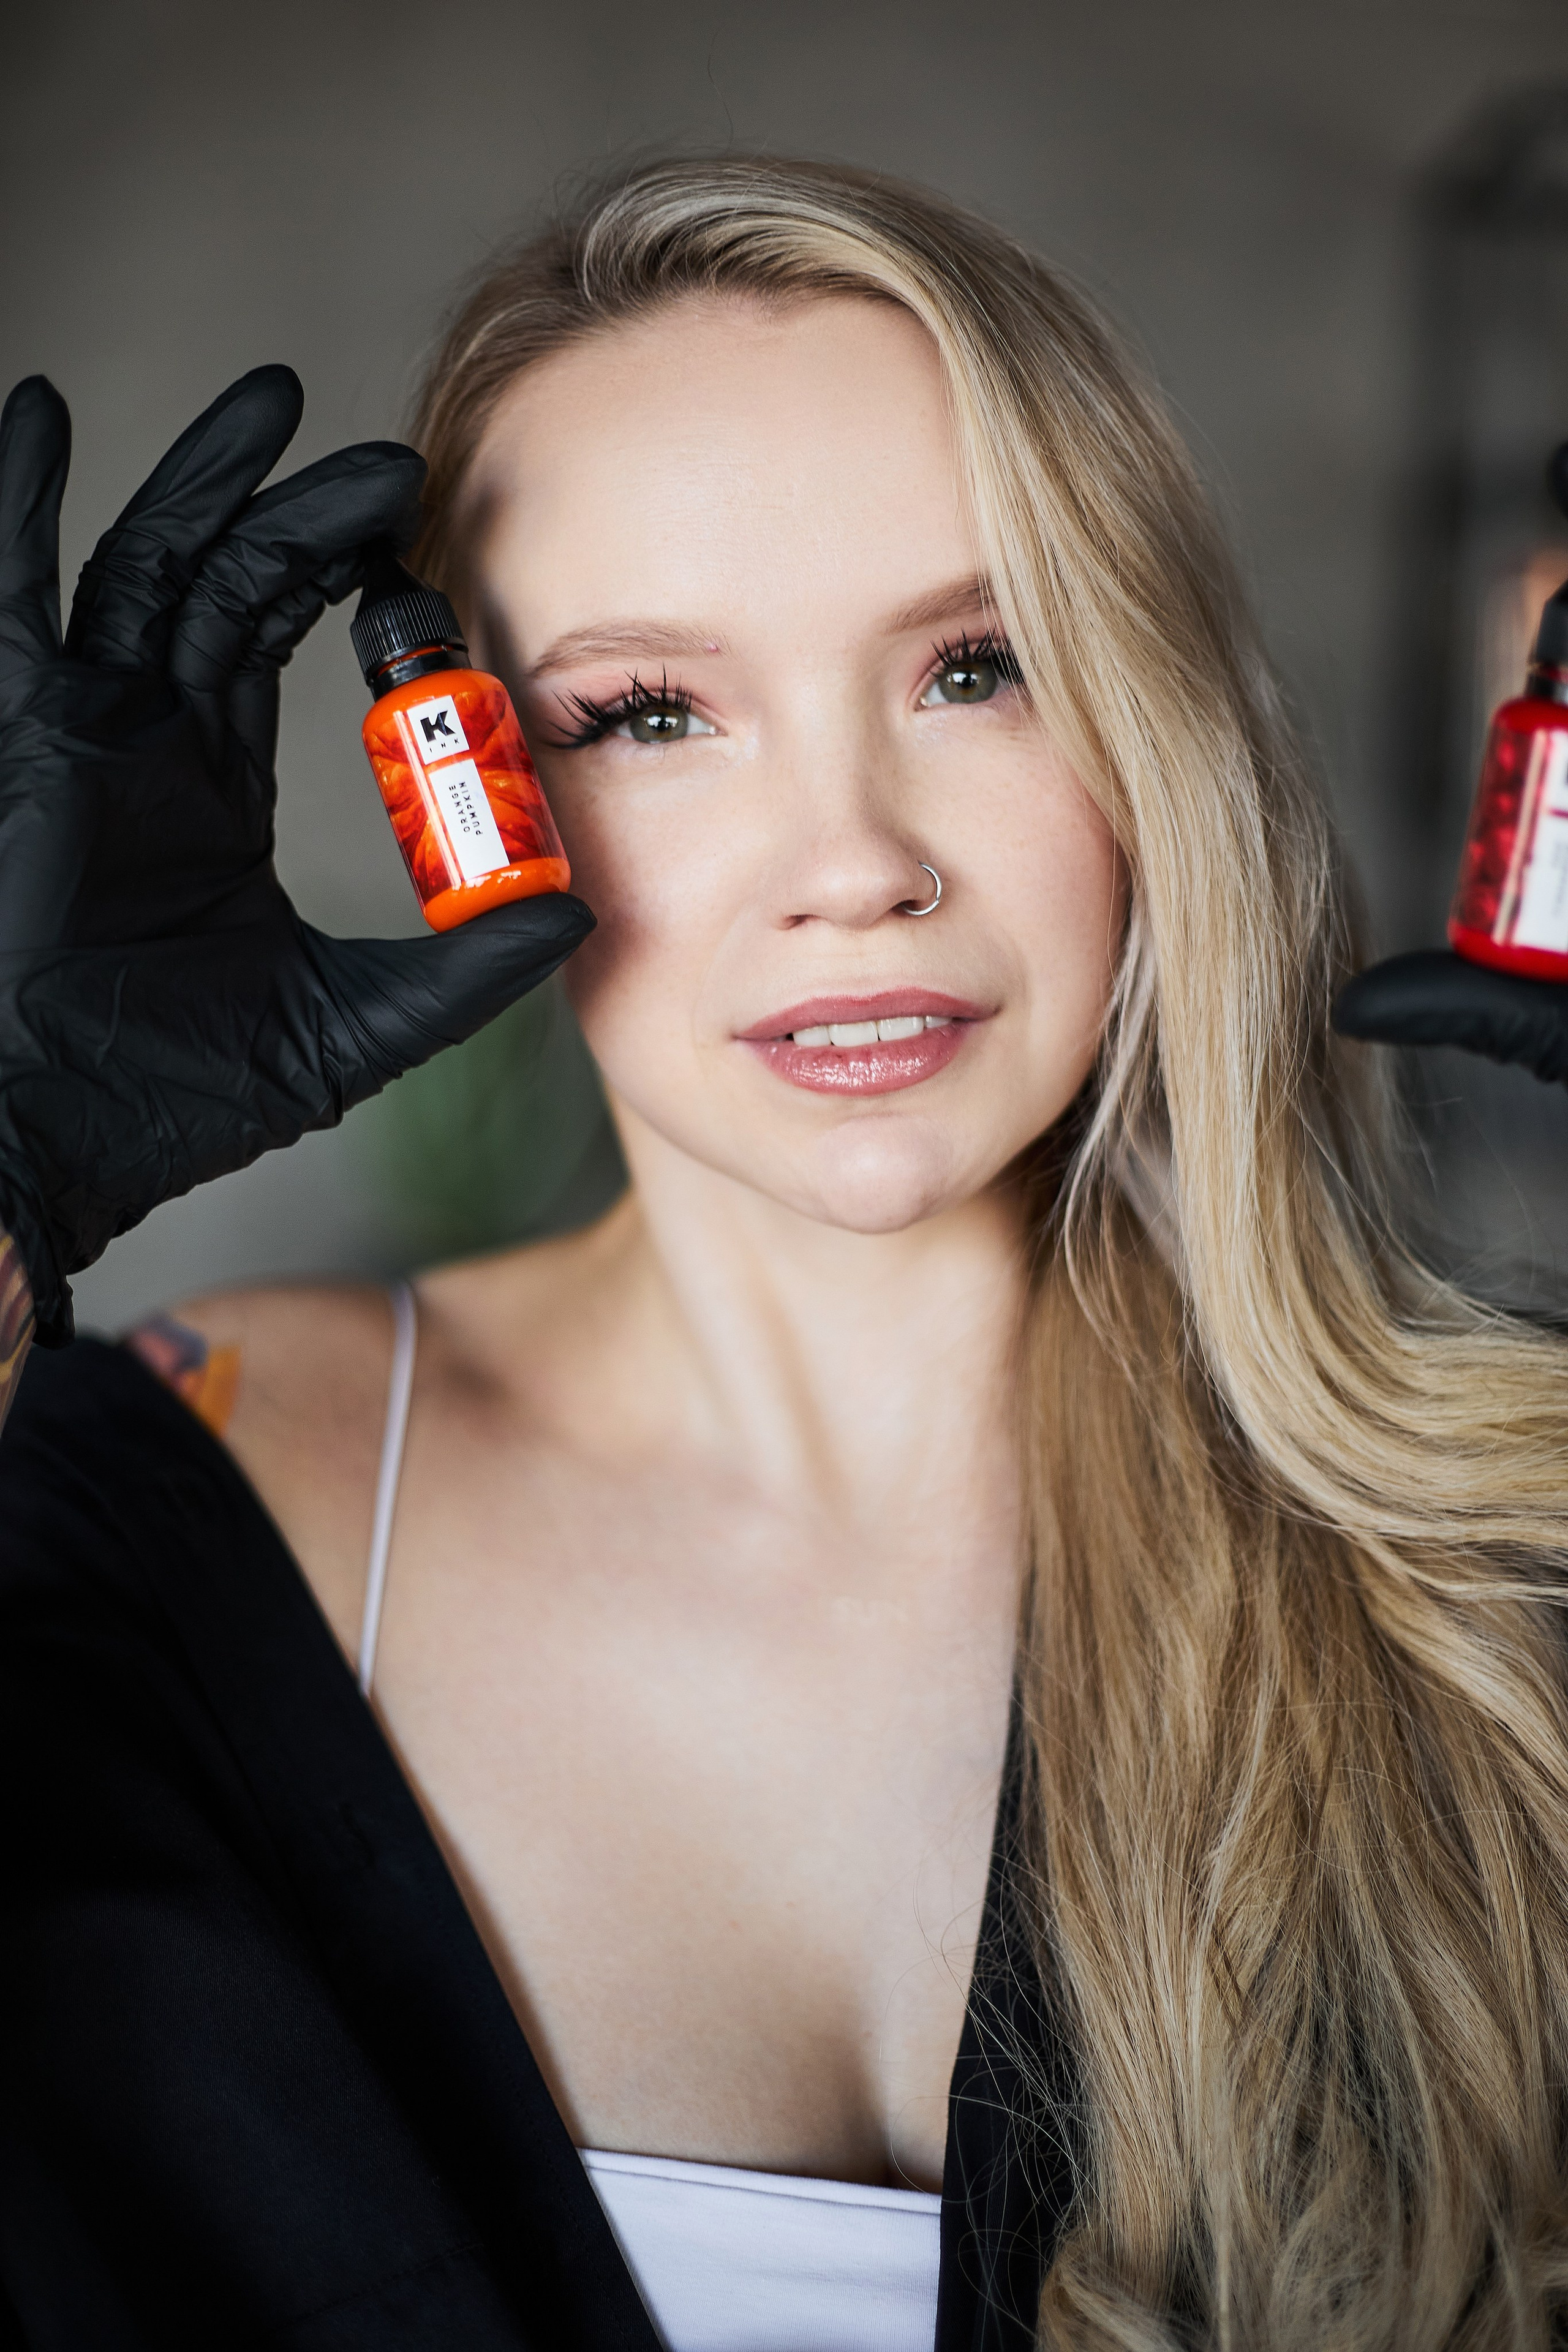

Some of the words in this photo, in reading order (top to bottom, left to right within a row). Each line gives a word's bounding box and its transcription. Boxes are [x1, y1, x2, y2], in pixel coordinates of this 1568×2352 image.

[420, 710, 456, 742] K
[429, 739, 459, 752] INK
[448, 785, 470, 832] ORANGE
[459, 781, 483, 835] PUMPKIN
